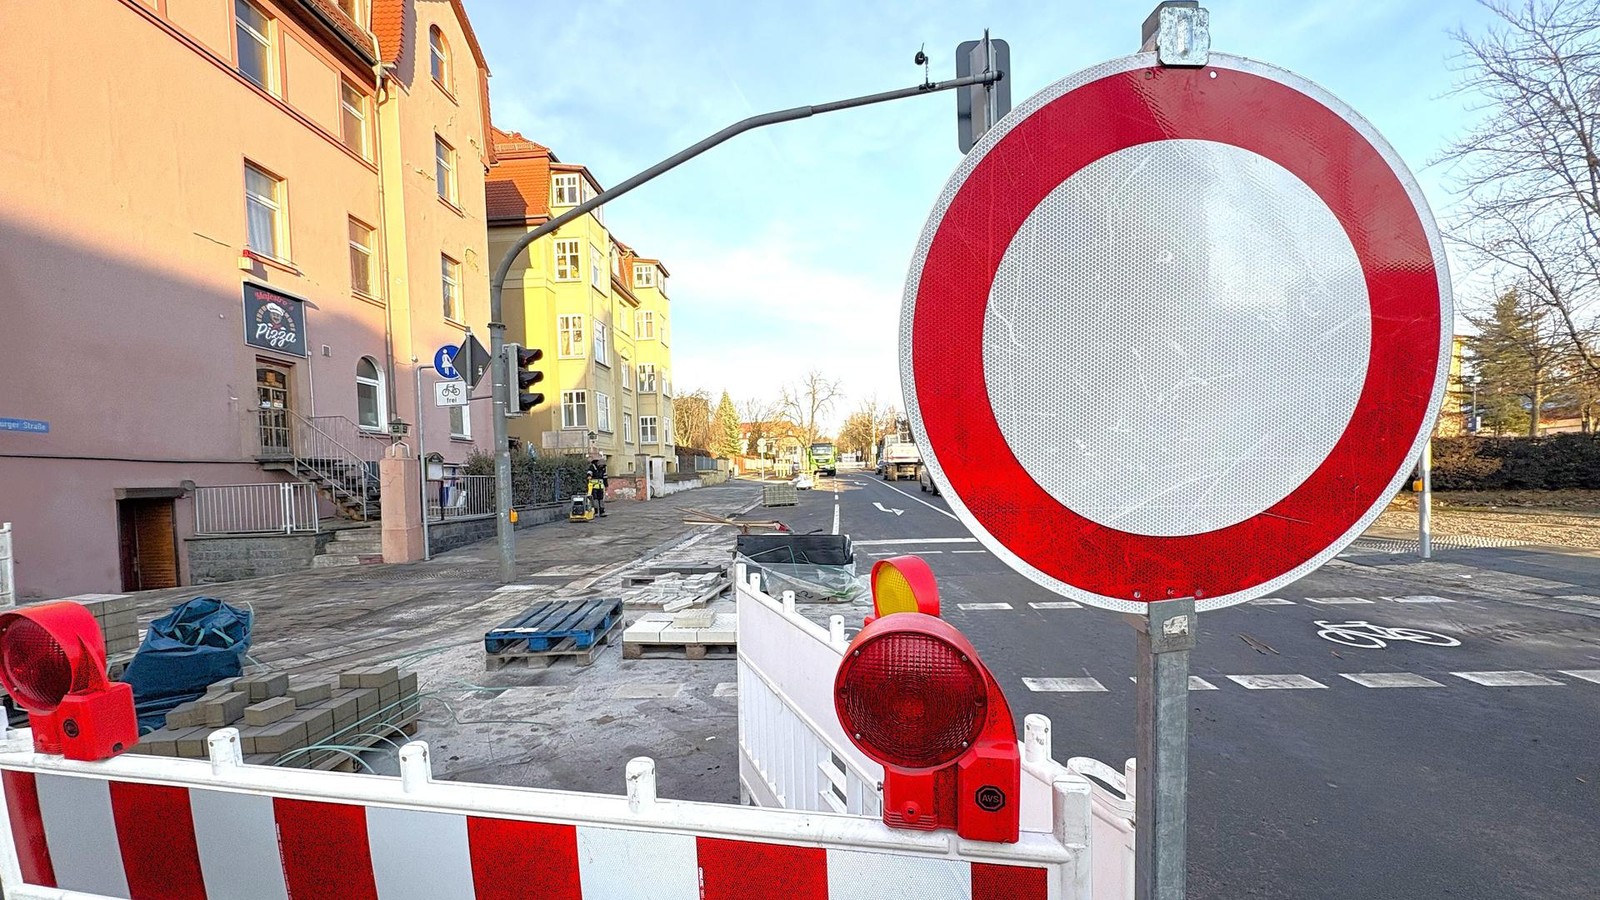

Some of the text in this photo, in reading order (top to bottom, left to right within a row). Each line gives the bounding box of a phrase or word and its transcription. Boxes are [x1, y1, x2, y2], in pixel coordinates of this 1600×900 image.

[255, 322, 297, 348] Pizza
[23, 421, 46, 431] Straße
[982, 794, 1000, 803] AVS
